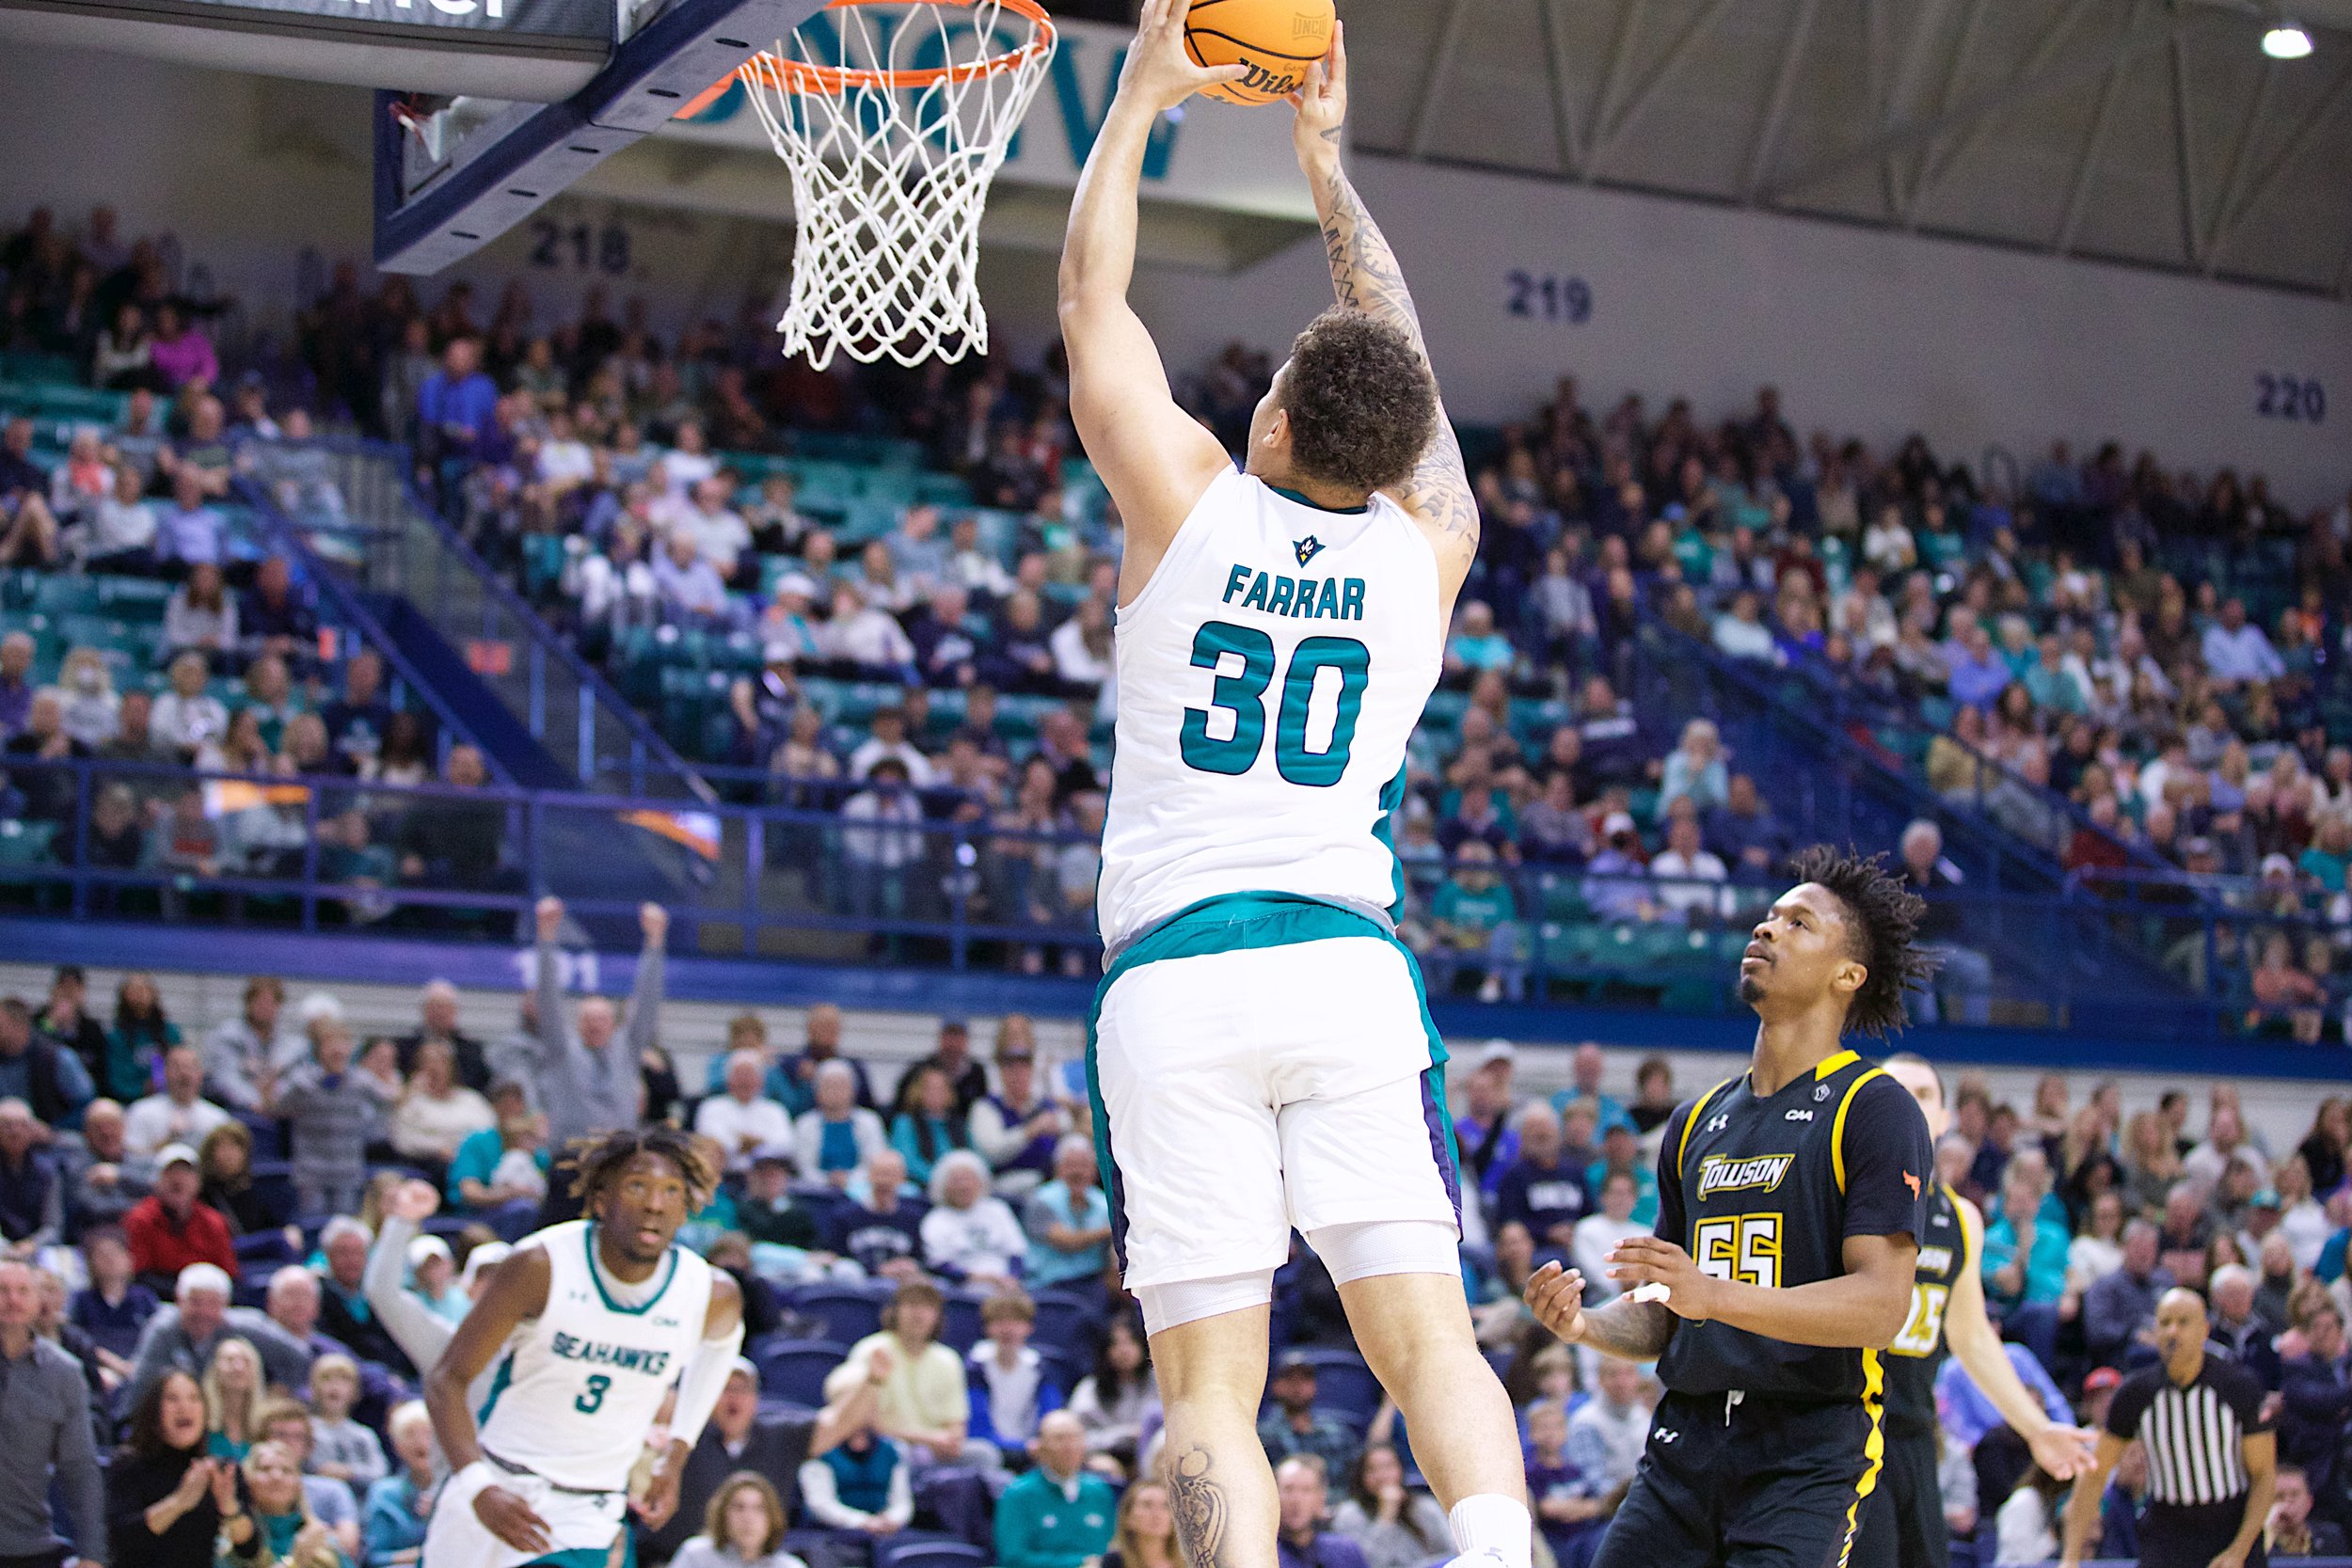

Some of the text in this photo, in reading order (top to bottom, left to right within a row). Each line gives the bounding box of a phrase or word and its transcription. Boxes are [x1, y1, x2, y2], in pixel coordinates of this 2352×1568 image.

[691, 8, 1188, 181] NCW
[530, 218, 631, 276] 218
[1506, 269, 1593, 324] 219
[2256, 373, 2326, 425] 220
[1222, 563, 1365, 621] FARRAR
[1179, 620, 1372, 788] 30
[1784, 1109, 1814, 1122] CAA
[1693, 1212, 1783, 1289] 55
[551, 1331, 670, 1376] SEAHAWKS
[574, 1374, 612, 1415] 3
